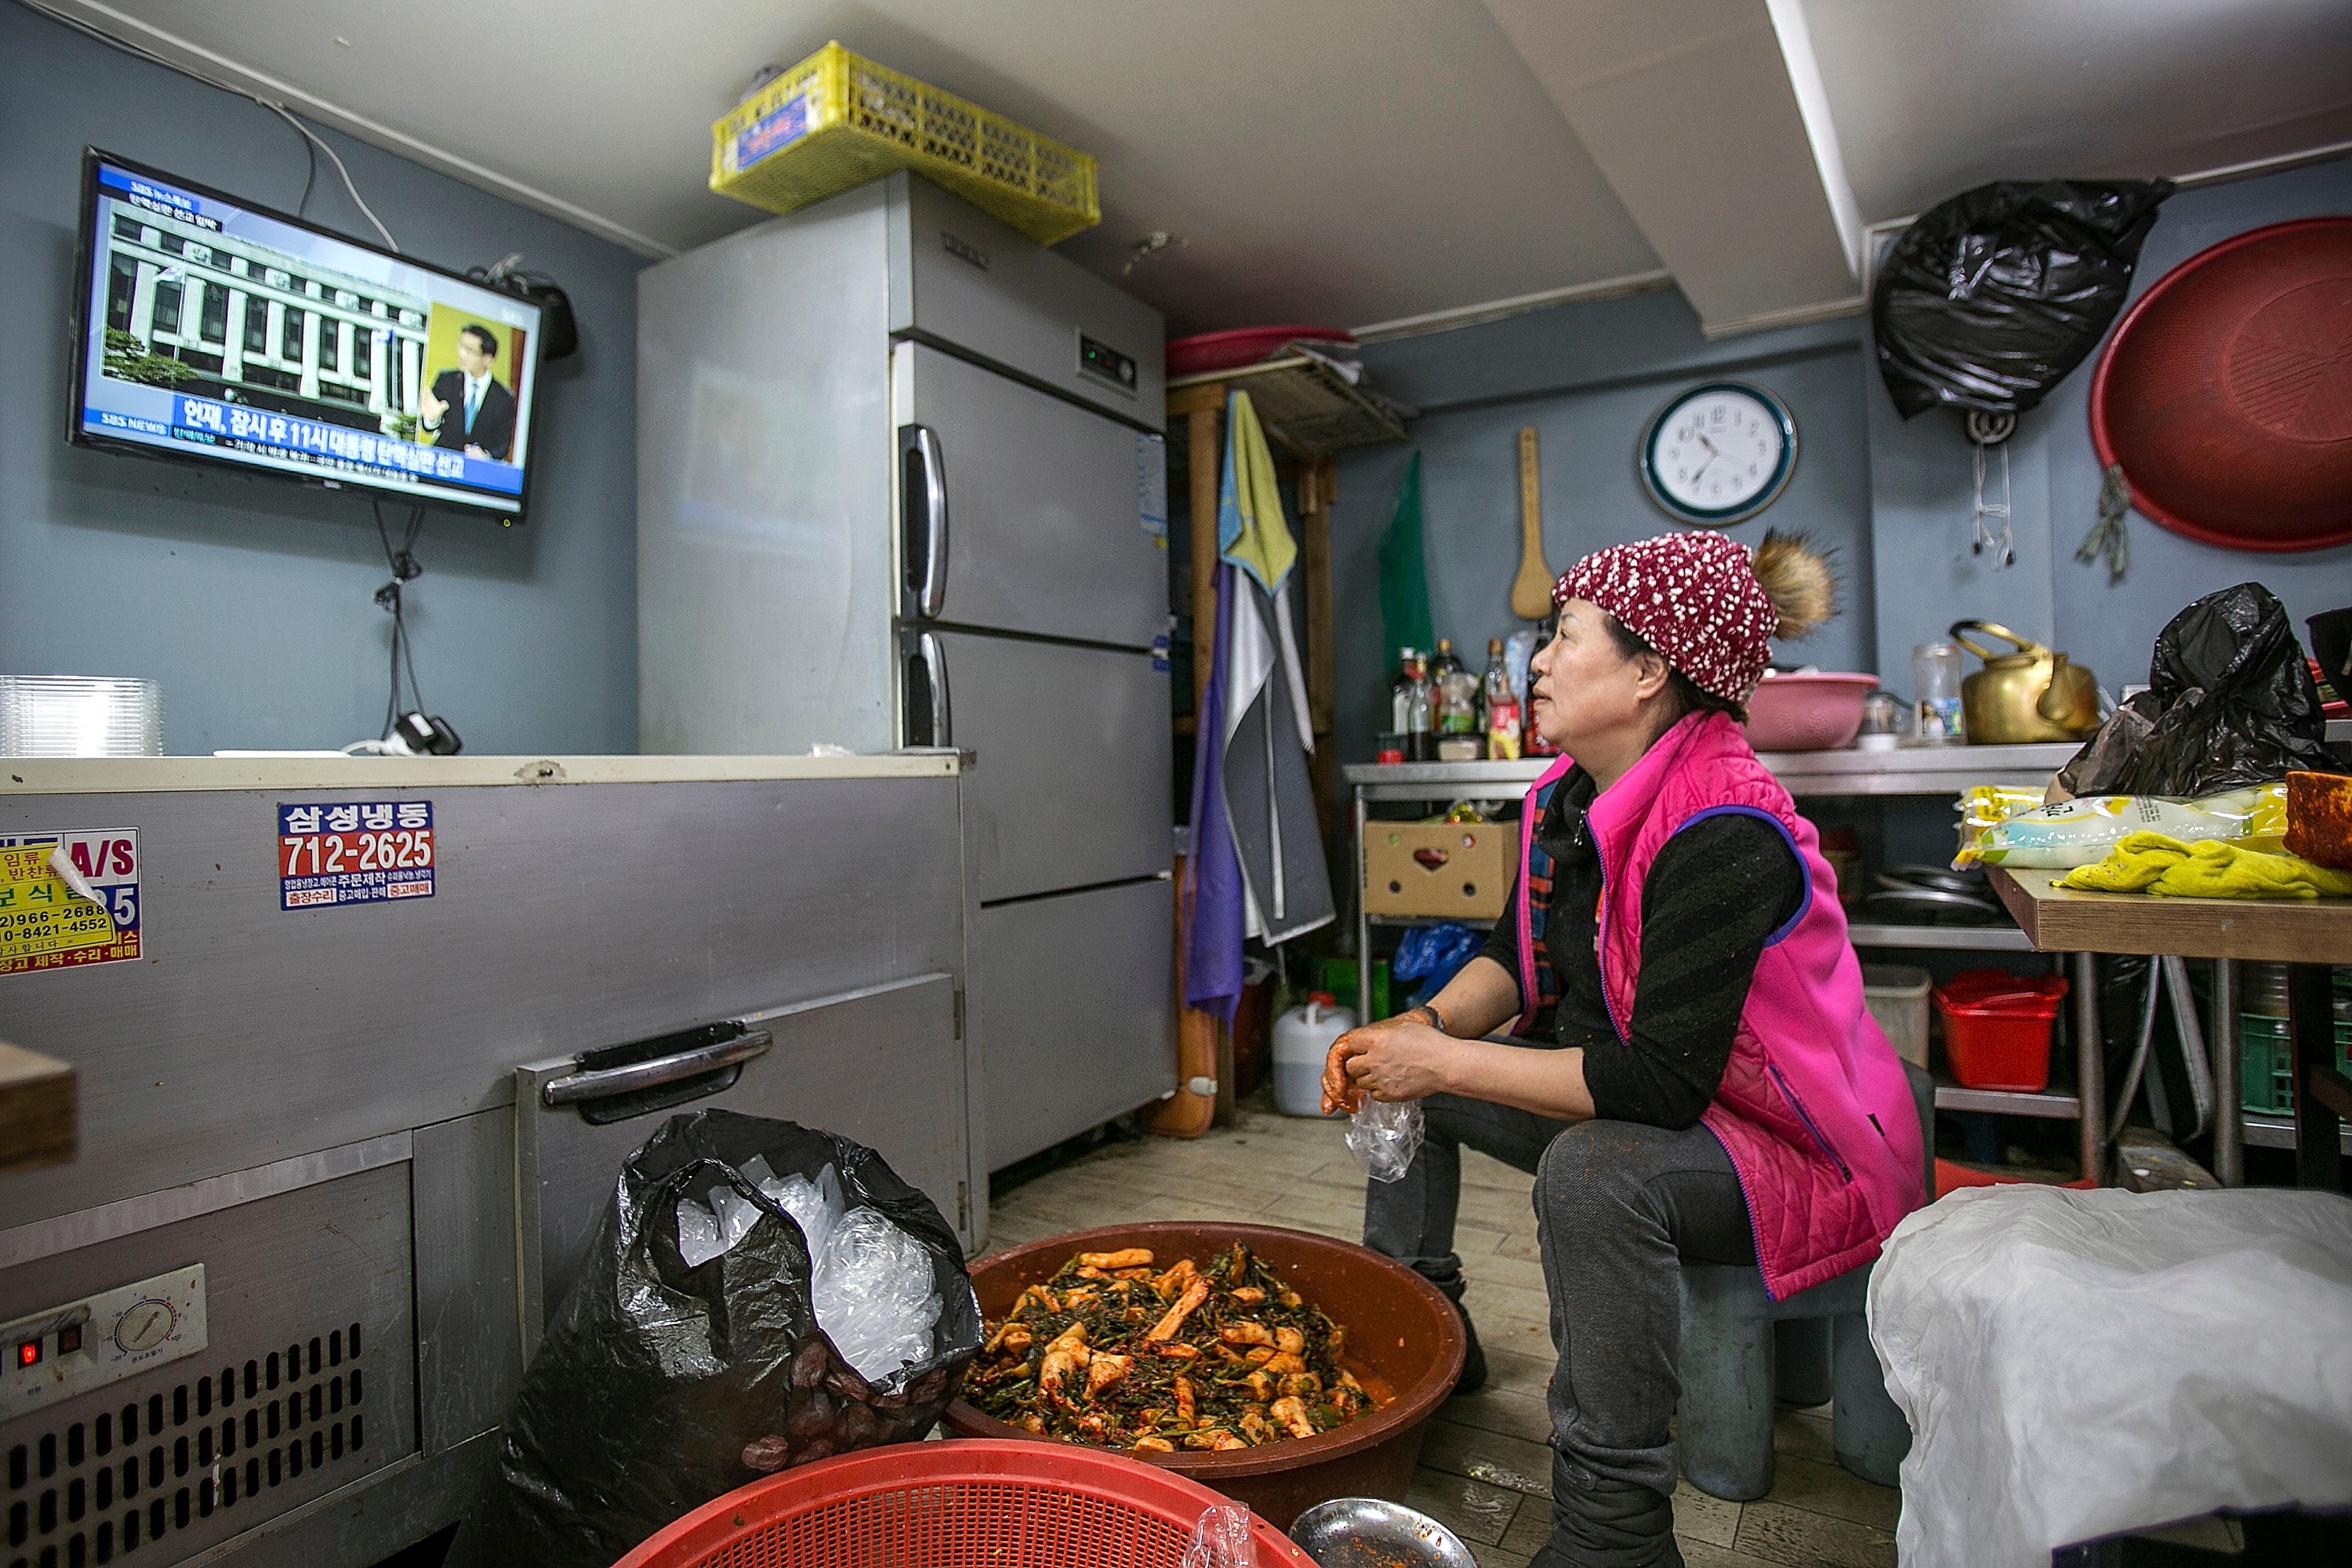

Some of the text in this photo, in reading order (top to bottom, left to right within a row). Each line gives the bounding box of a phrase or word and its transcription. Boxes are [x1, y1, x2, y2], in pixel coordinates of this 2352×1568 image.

[101, 412, 127, 427] SBS
[128, 417, 167, 435] NEWS
[183, 399, 227, 434] 헌재,
[285, 803, 429, 833] 삼성냉동
[71, 839, 134, 878] A/S
[284, 830, 431, 876] 712-2625
[338, 872, 387, 887] 주문제작
[289, 889, 334, 904] 출장수리
[390, 883, 430, 896] 중고매매
[0, 905, 105, 927] 2)966-2688
[0, 918, 107, 942] 0-8421-4552
